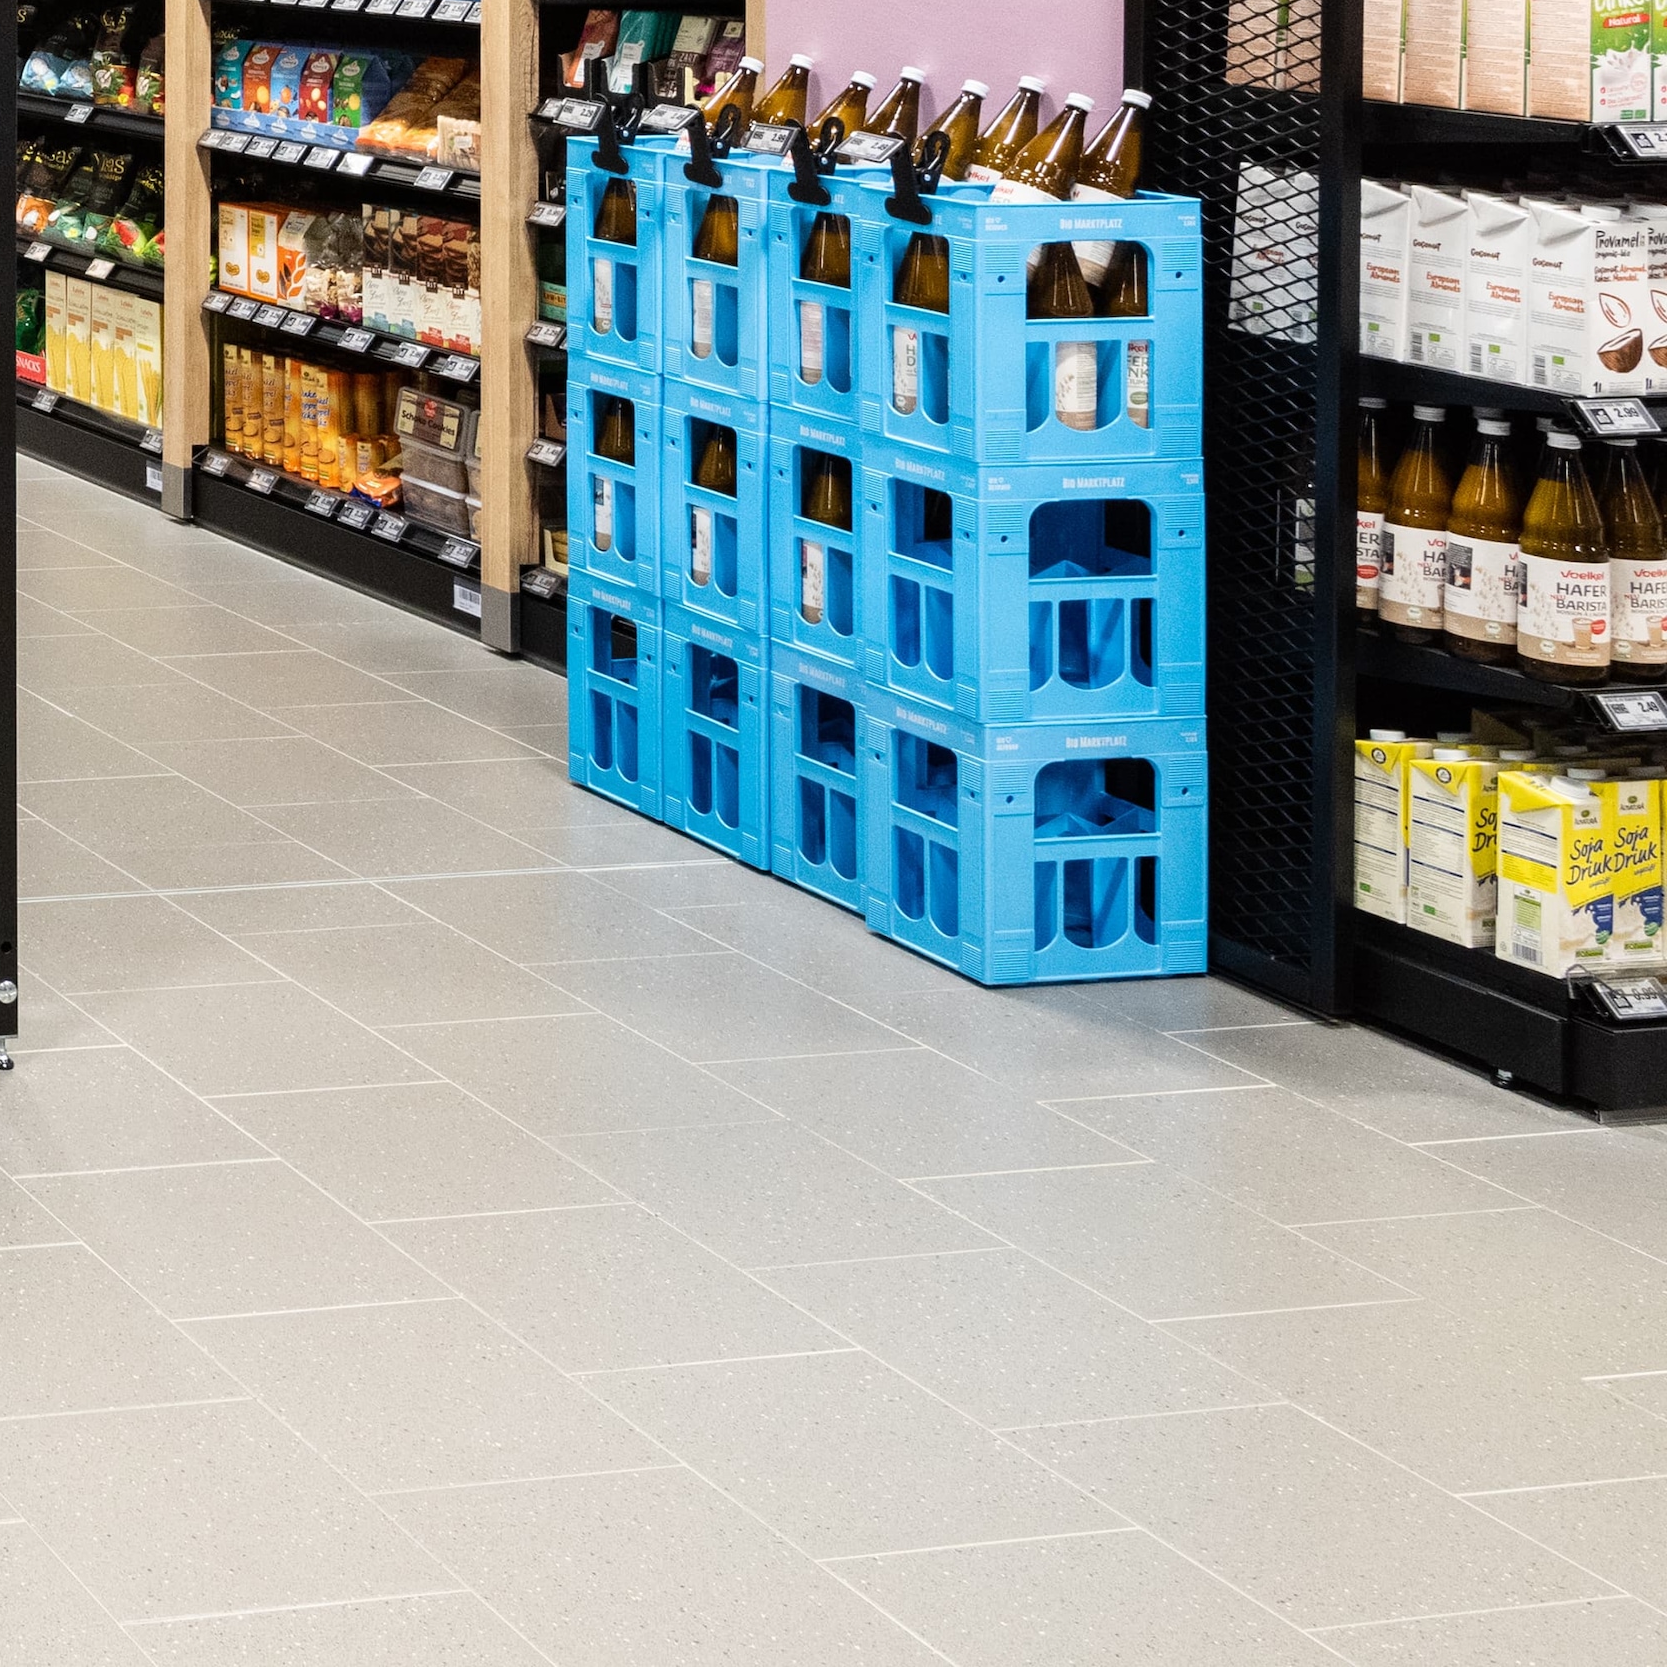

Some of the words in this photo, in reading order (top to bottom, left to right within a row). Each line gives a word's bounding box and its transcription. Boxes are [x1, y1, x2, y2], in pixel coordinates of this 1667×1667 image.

[1607, 14, 1641, 26] Natural
[1074, 219, 1122, 229] MARKTPLATZ
[1613, 407, 1639, 419] 2.99
[1560, 569, 1605, 581] Voelkel
[1555, 582, 1607, 597] HAFER
[1556, 598, 1608, 612] BARISTA
[1570, 839, 1603, 862] Soja
